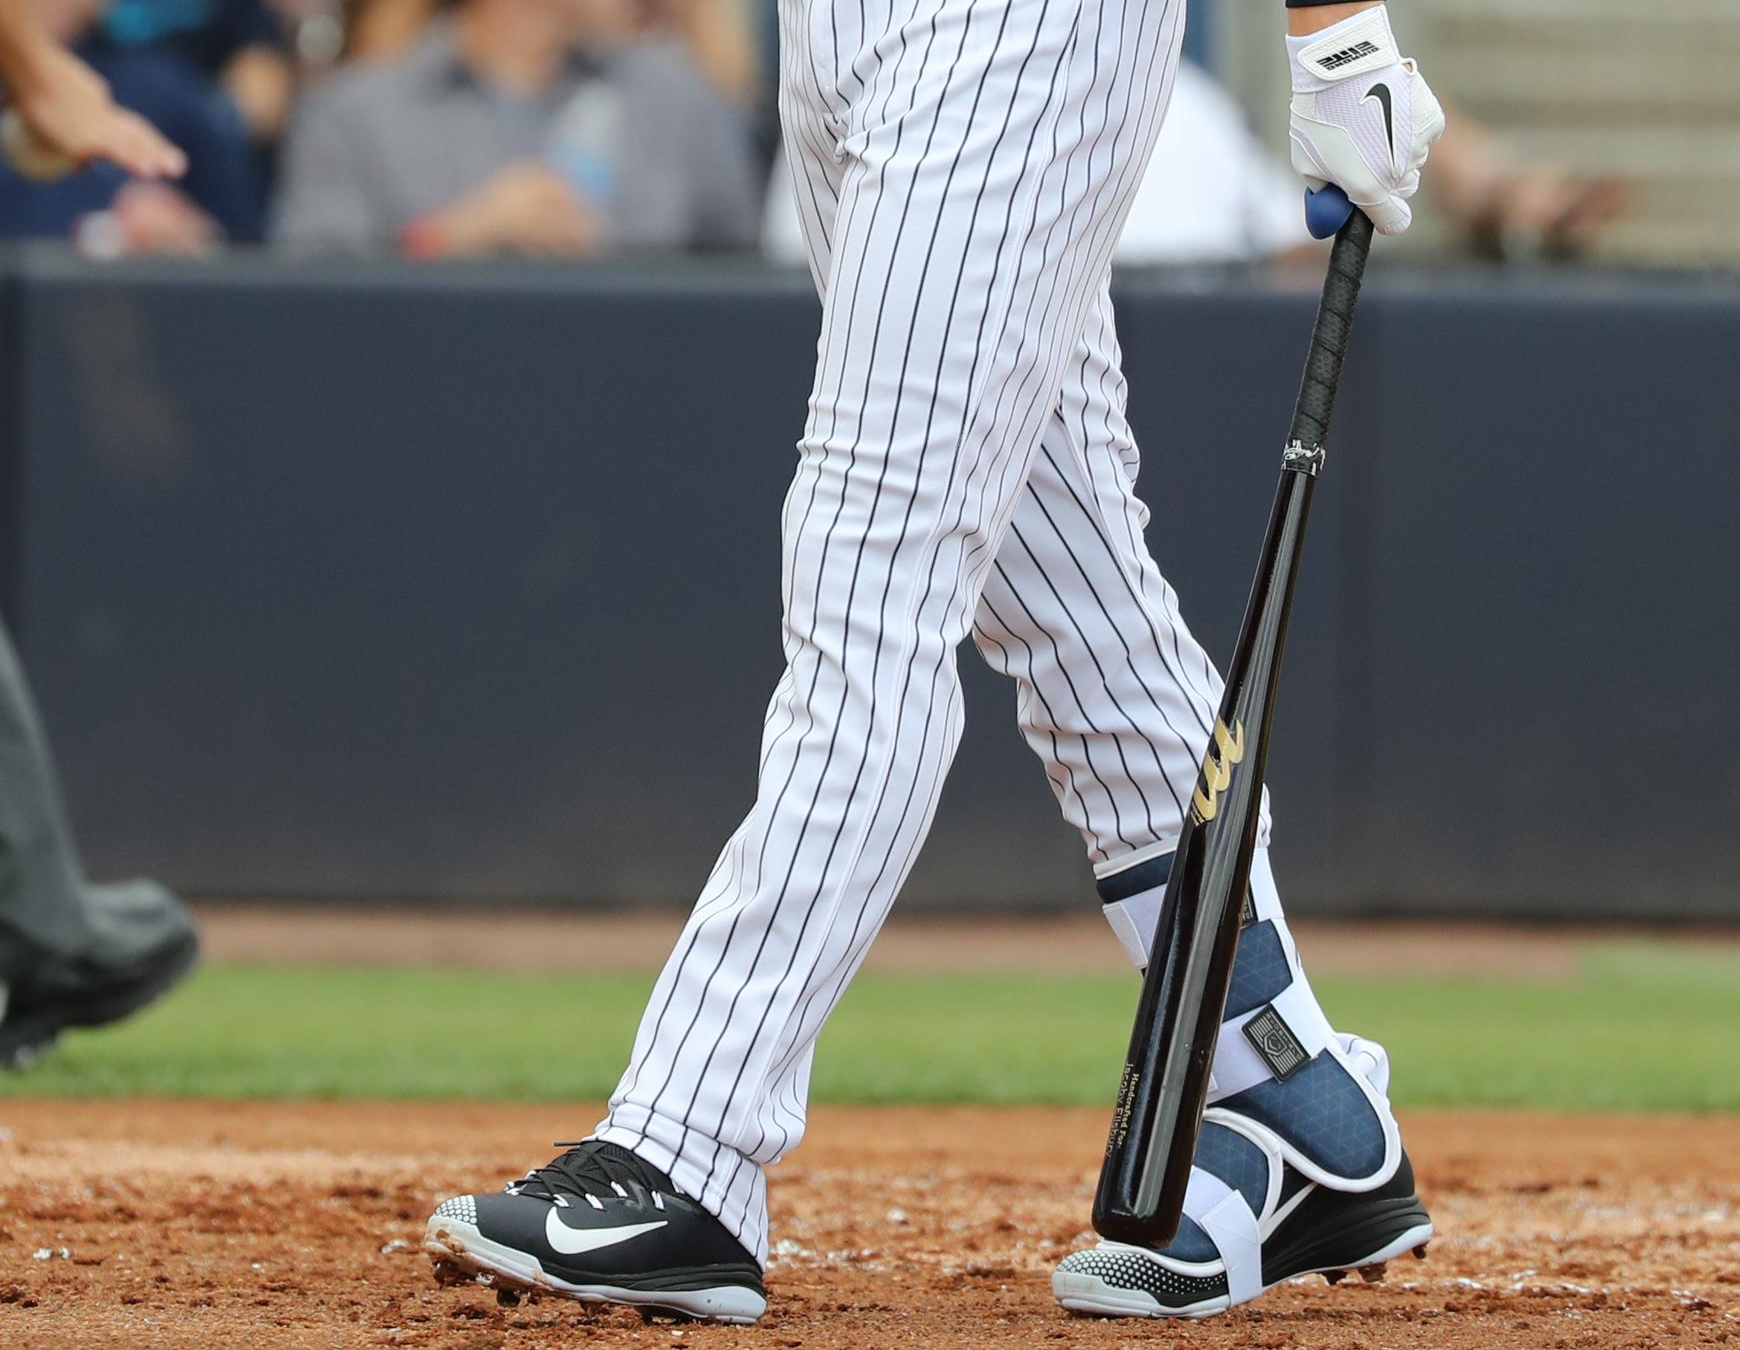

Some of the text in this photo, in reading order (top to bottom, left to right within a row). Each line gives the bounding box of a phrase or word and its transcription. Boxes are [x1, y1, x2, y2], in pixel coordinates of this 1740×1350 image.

[1326, 47, 1379, 70] DIAMOND
[1265, 1012, 1302, 1061] EVOSHIELD
[1120, 1073, 1140, 1129] Handcrafted
